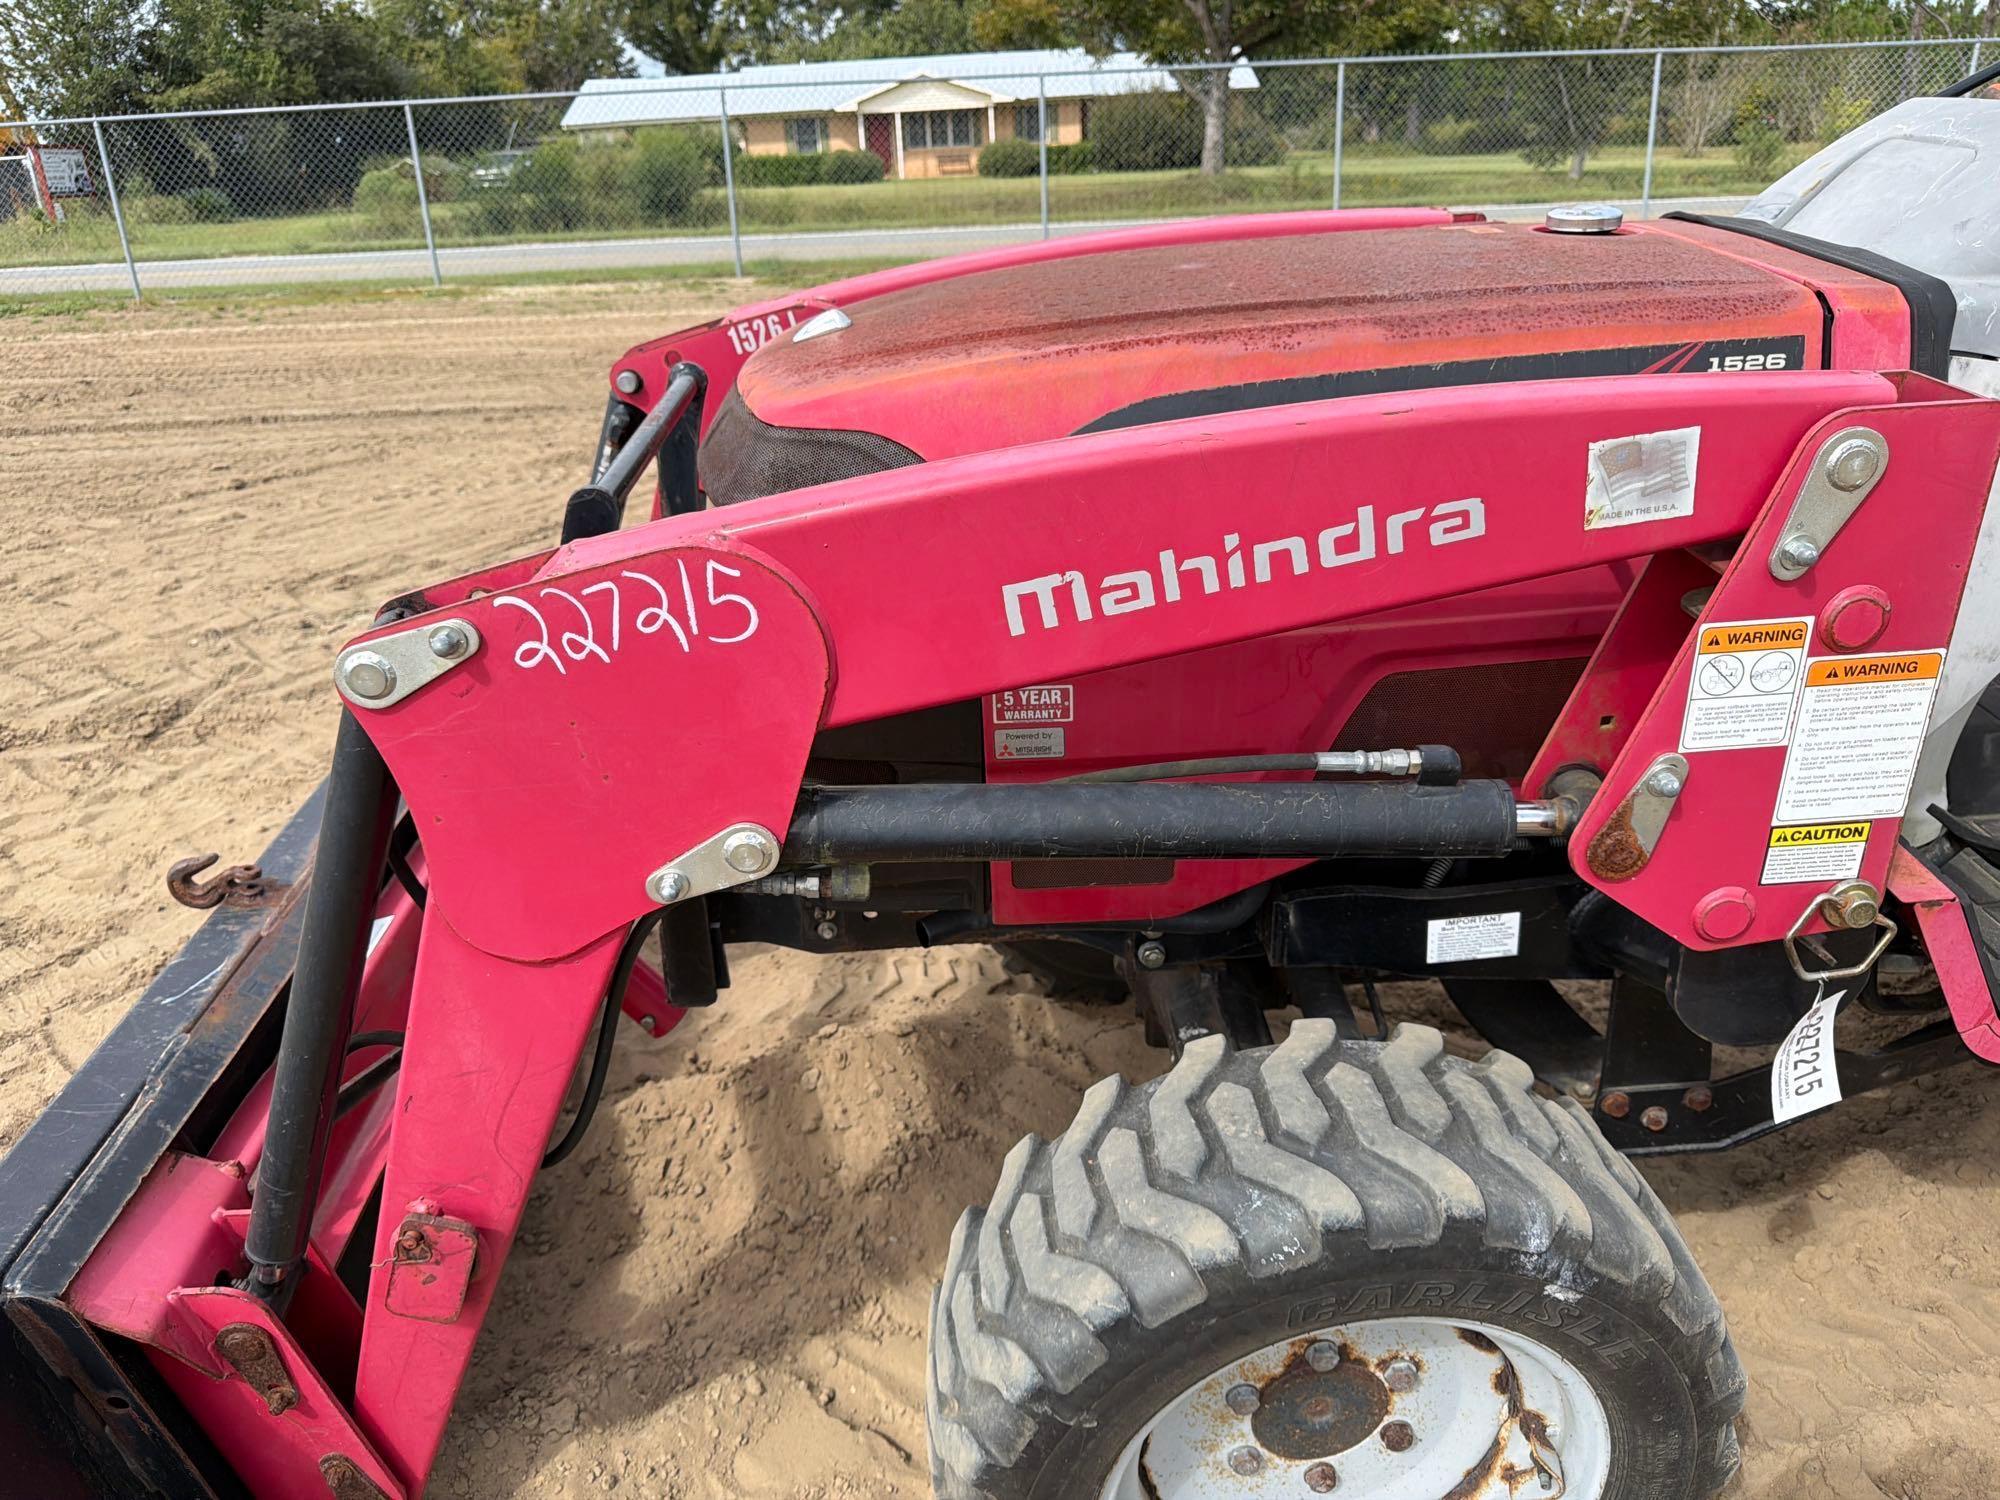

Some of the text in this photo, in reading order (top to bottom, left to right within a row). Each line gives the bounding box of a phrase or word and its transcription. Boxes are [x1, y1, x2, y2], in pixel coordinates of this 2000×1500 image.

[1707, 353, 1787, 372] 1526
[1598, 503, 1678, 521] MADE IN THE U.S.A.
[1002, 497, 1486, 637] Mahindra
[493, 558, 759, 675] 227215
[1727, 628, 1804, 646] WARNING
[1843, 661, 1919, 678] WARNING
[1004, 689, 1062, 706] 5 YEAR
[1004, 709, 1062, 720] WARRANTY
[1006, 732, 1053, 741] Powered by
[1790, 826, 1865, 842] CAUTION
[1445, 915, 1503, 926] IMPORTANT
[1794, 1015, 1824, 1096] 227215
[1285, 1280, 1649, 1370] CARLISLE
